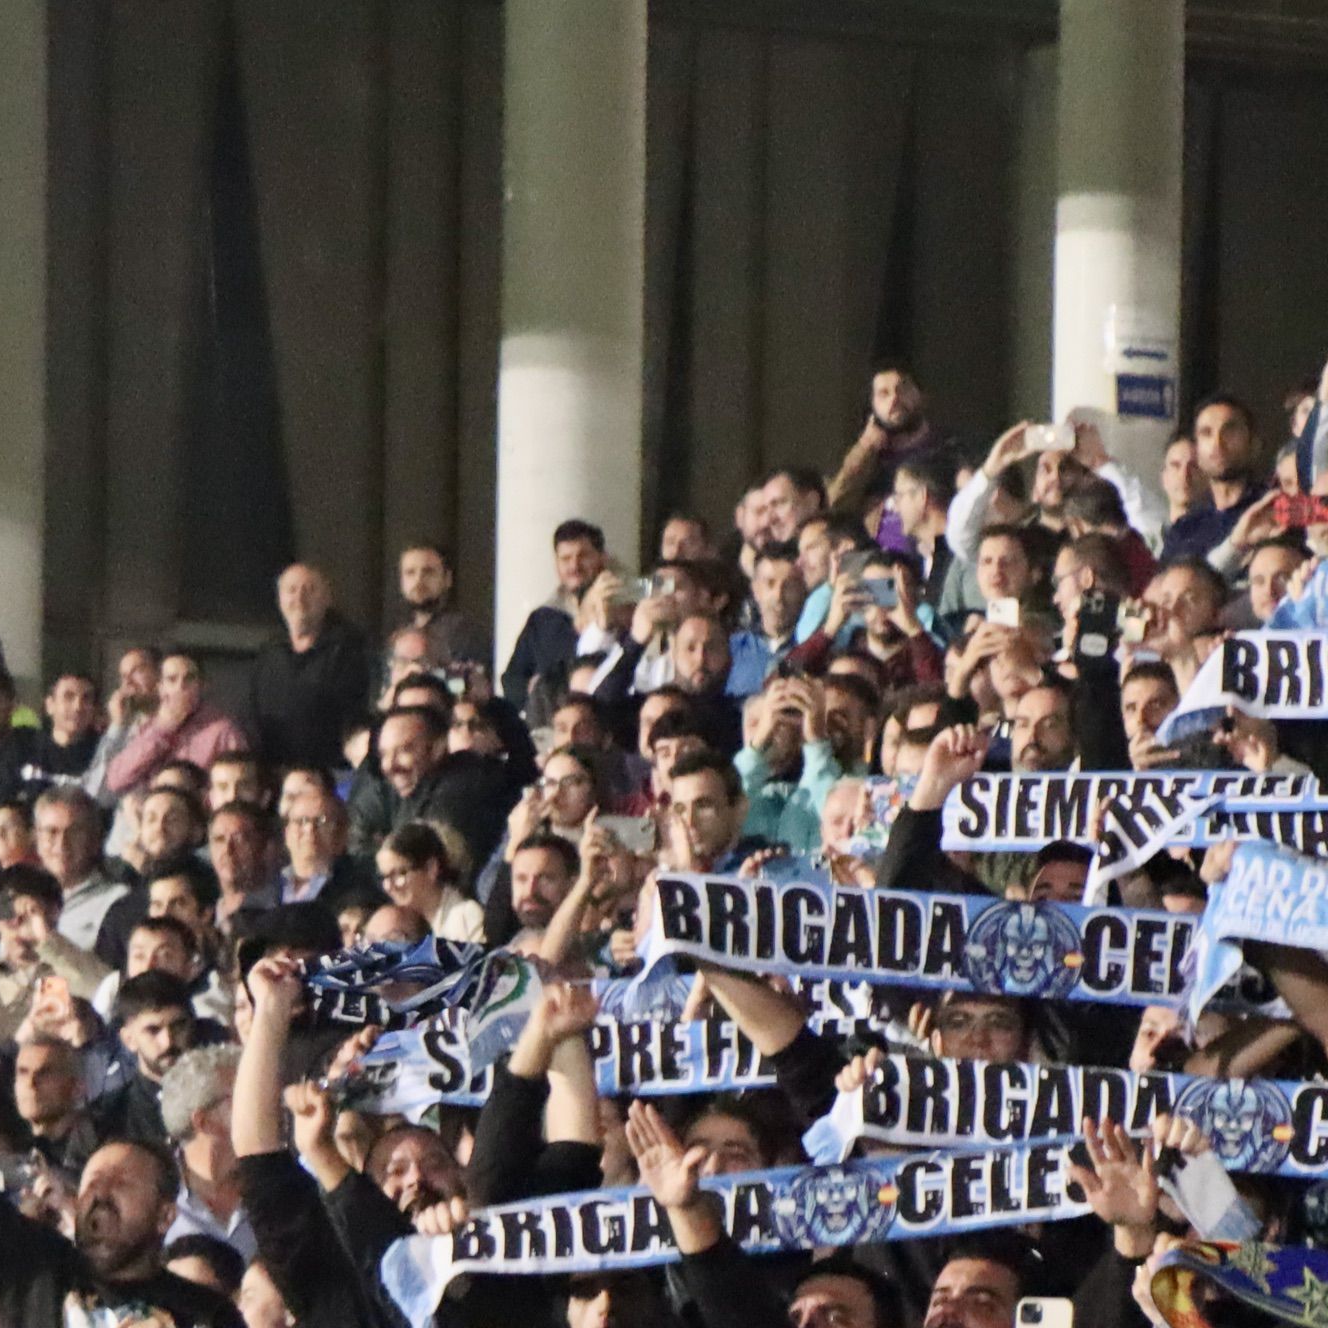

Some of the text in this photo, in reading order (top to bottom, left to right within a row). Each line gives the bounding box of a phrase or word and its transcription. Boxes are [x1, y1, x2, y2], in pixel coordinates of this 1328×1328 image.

[655, 879, 970, 980] BRIGADA
[862, 1056, 1175, 1141] BRIGADA
[453, 1184, 776, 1262] BRIGAA
